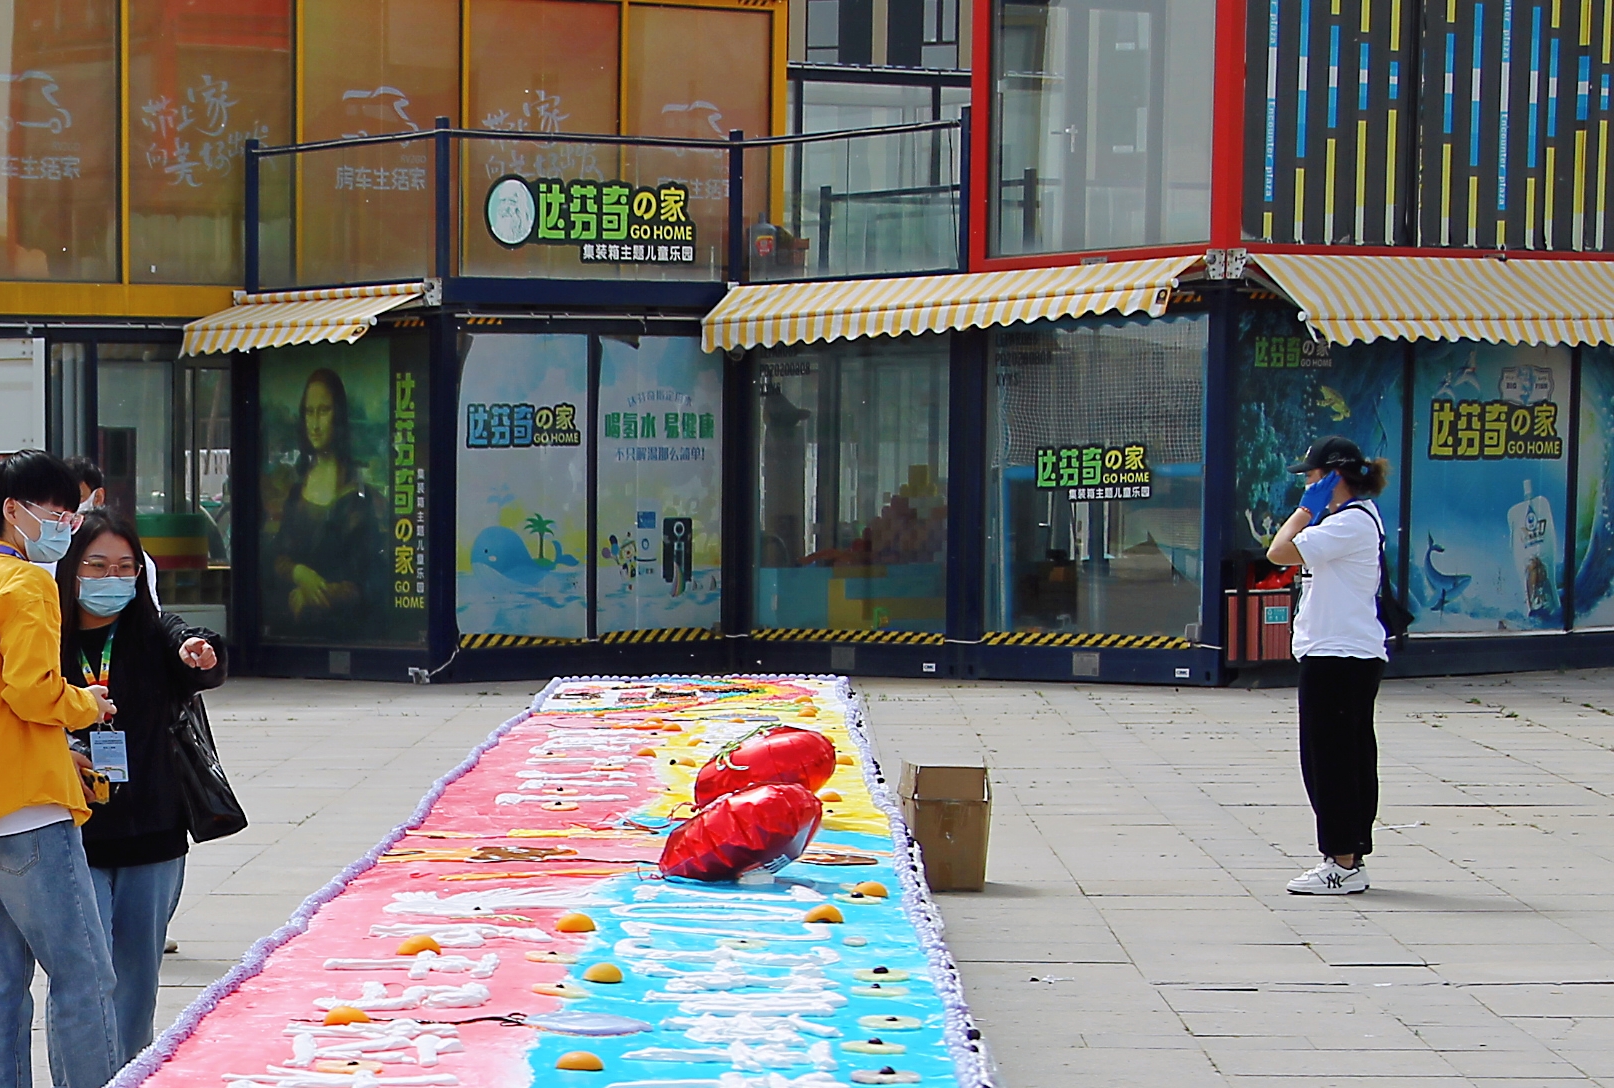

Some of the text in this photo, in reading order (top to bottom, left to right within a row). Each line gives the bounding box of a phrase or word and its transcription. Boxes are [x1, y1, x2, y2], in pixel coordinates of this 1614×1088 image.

[538, 183, 686, 241] 达芬奇の家
[630, 225, 692, 240] GO HOME
[583, 244, 693, 261] 集装箱主题儿童乐园
[1300, 358, 1332, 367] GO HOME
[467, 404, 576, 446] 达芬奇の家
[1431, 403, 1558, 456] 达芬奇の家
[534, 433, 579, 444] GO HOME
[1507, 440, 1560, 455] GO HOME
[394, 373, 416, 576] 达芬奇の家
[1037, 446, 1144, 488] 达芬奇の家
[1103, 472, 1149, 484] GO HOME
[1068, 486, 1150, 499] 集装箱主题儿童乐园
[416, 468, 425, 594] 集装箱主题儿童乐园
[395, 581, 410, 593] GO
[395, 596, 425, 609] HOME
